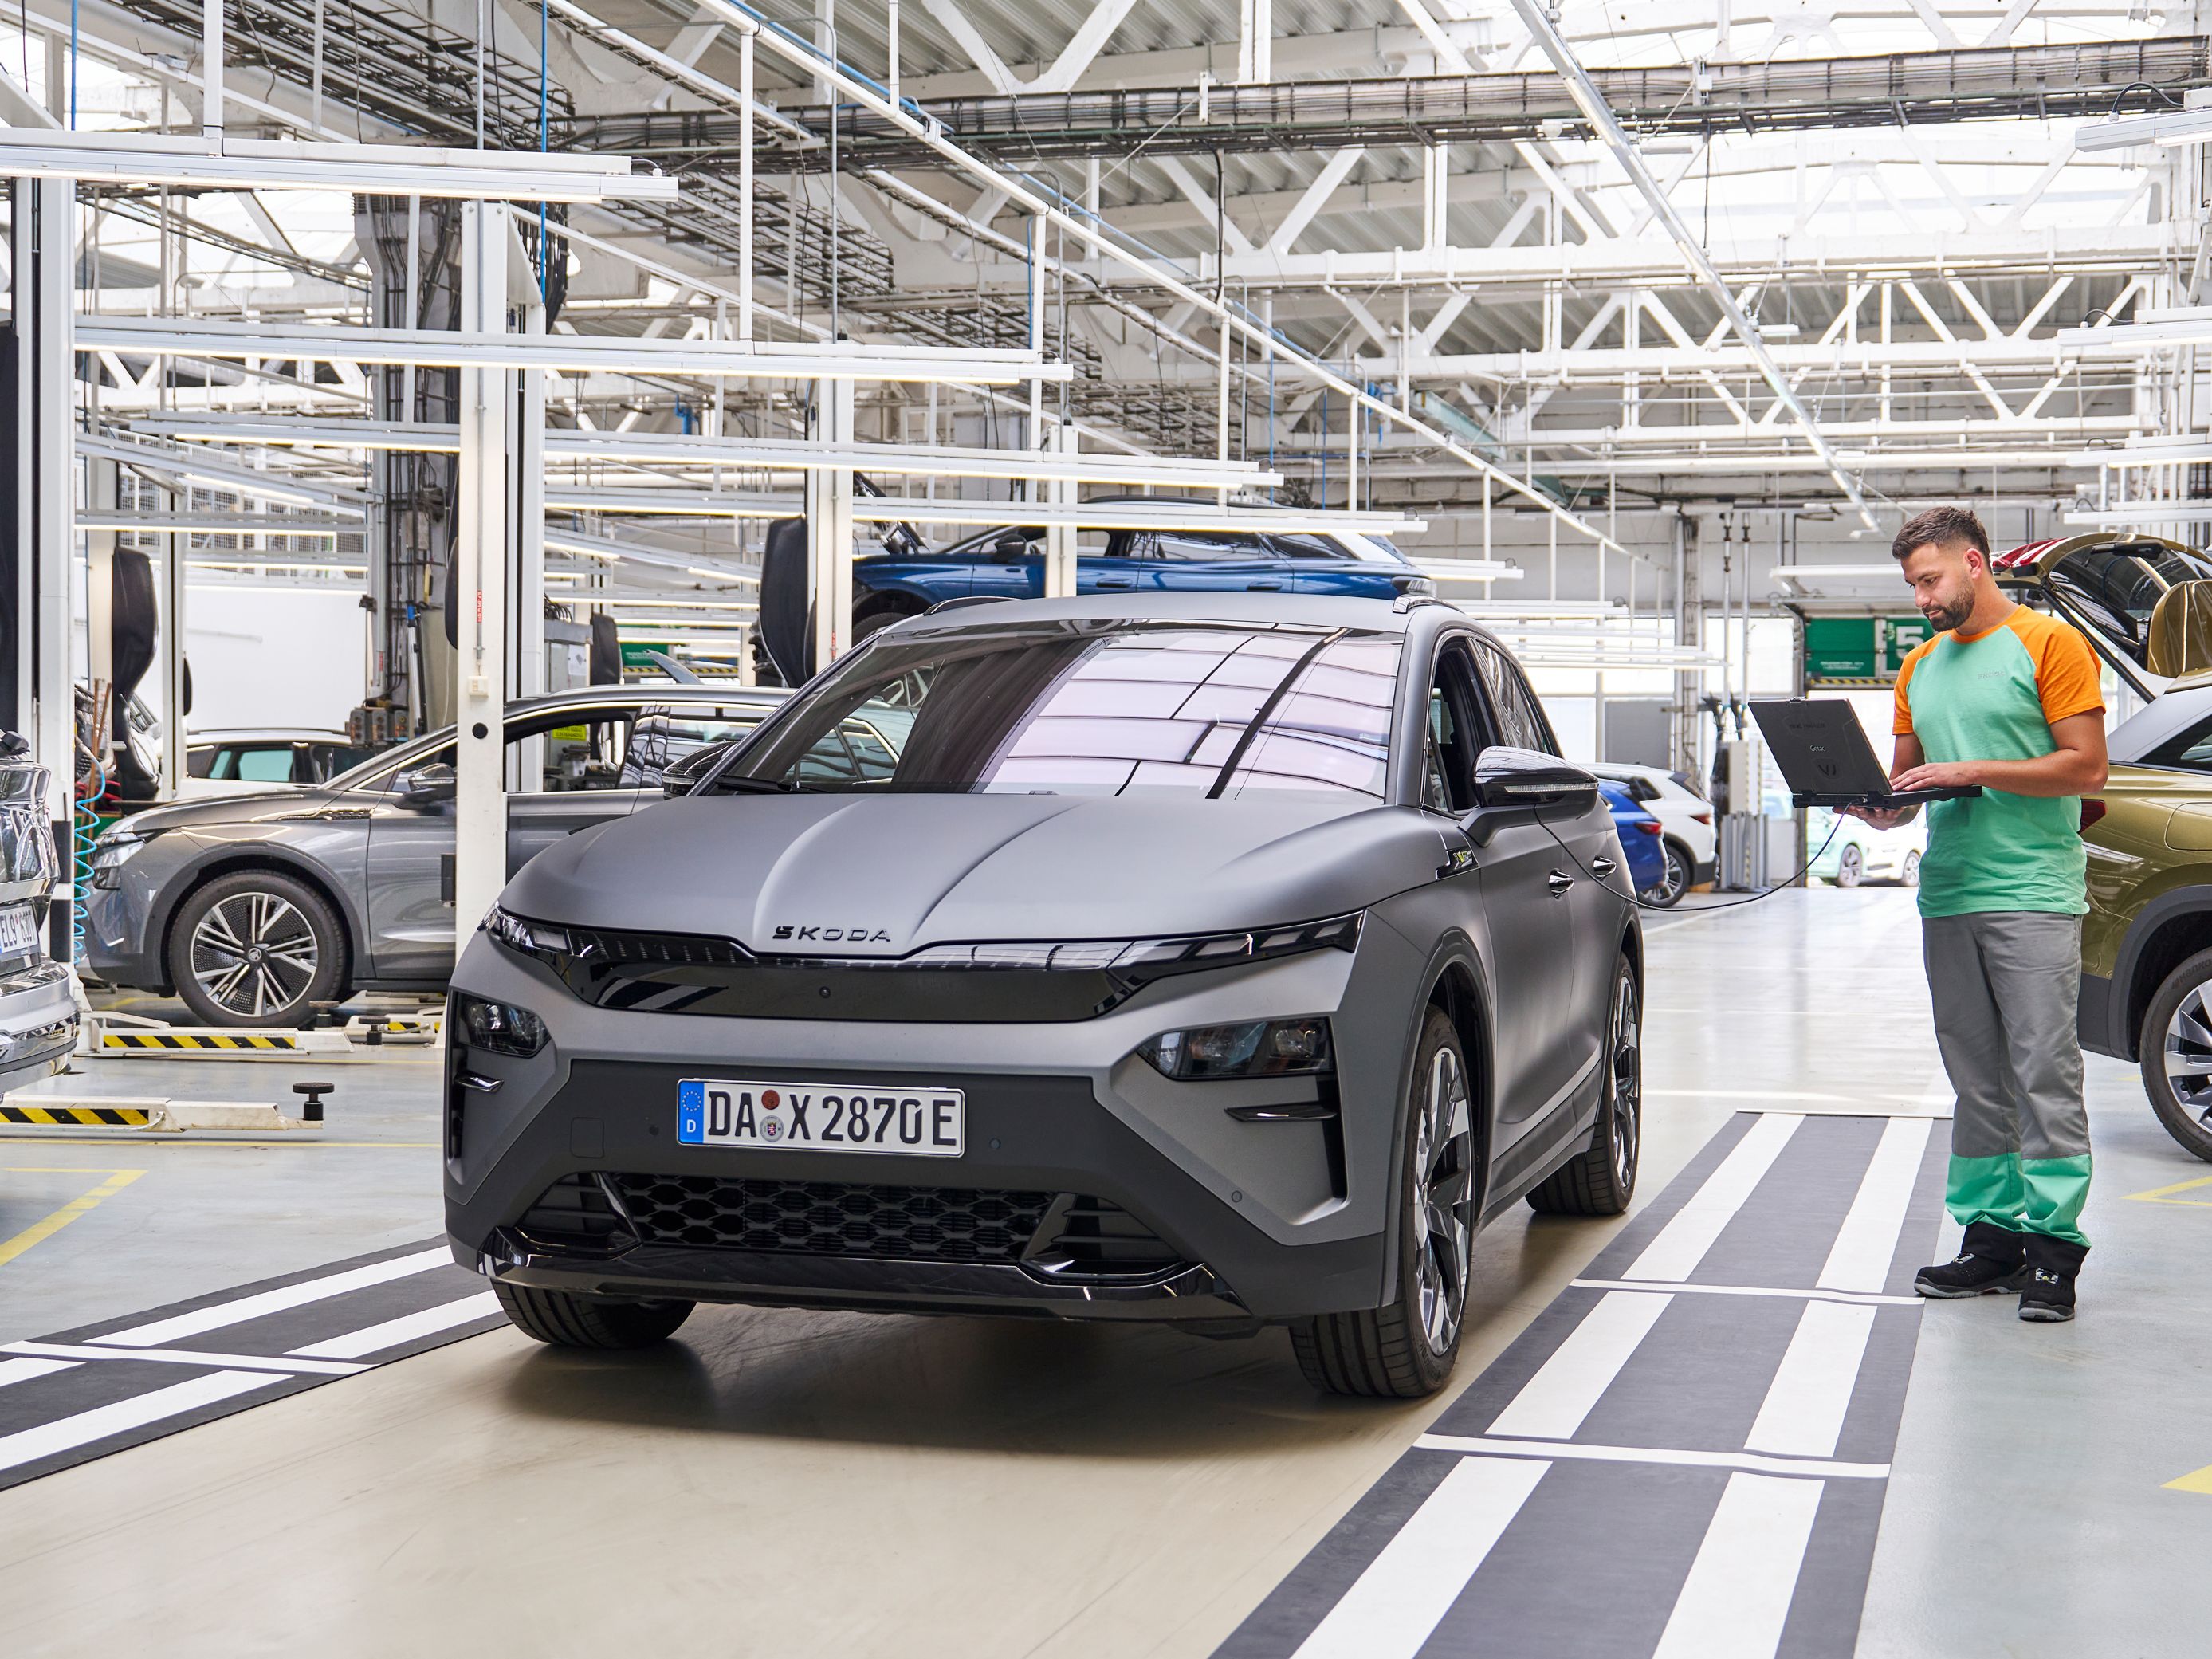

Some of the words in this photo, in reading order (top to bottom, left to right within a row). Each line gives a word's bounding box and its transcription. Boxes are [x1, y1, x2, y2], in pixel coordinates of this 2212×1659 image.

[772, 926, 890, 942] SKODA
[708, 1091, 757, 1138] DA
[788, 1094, 811, 1140] X
[686, 1119, 697, 1133] D
